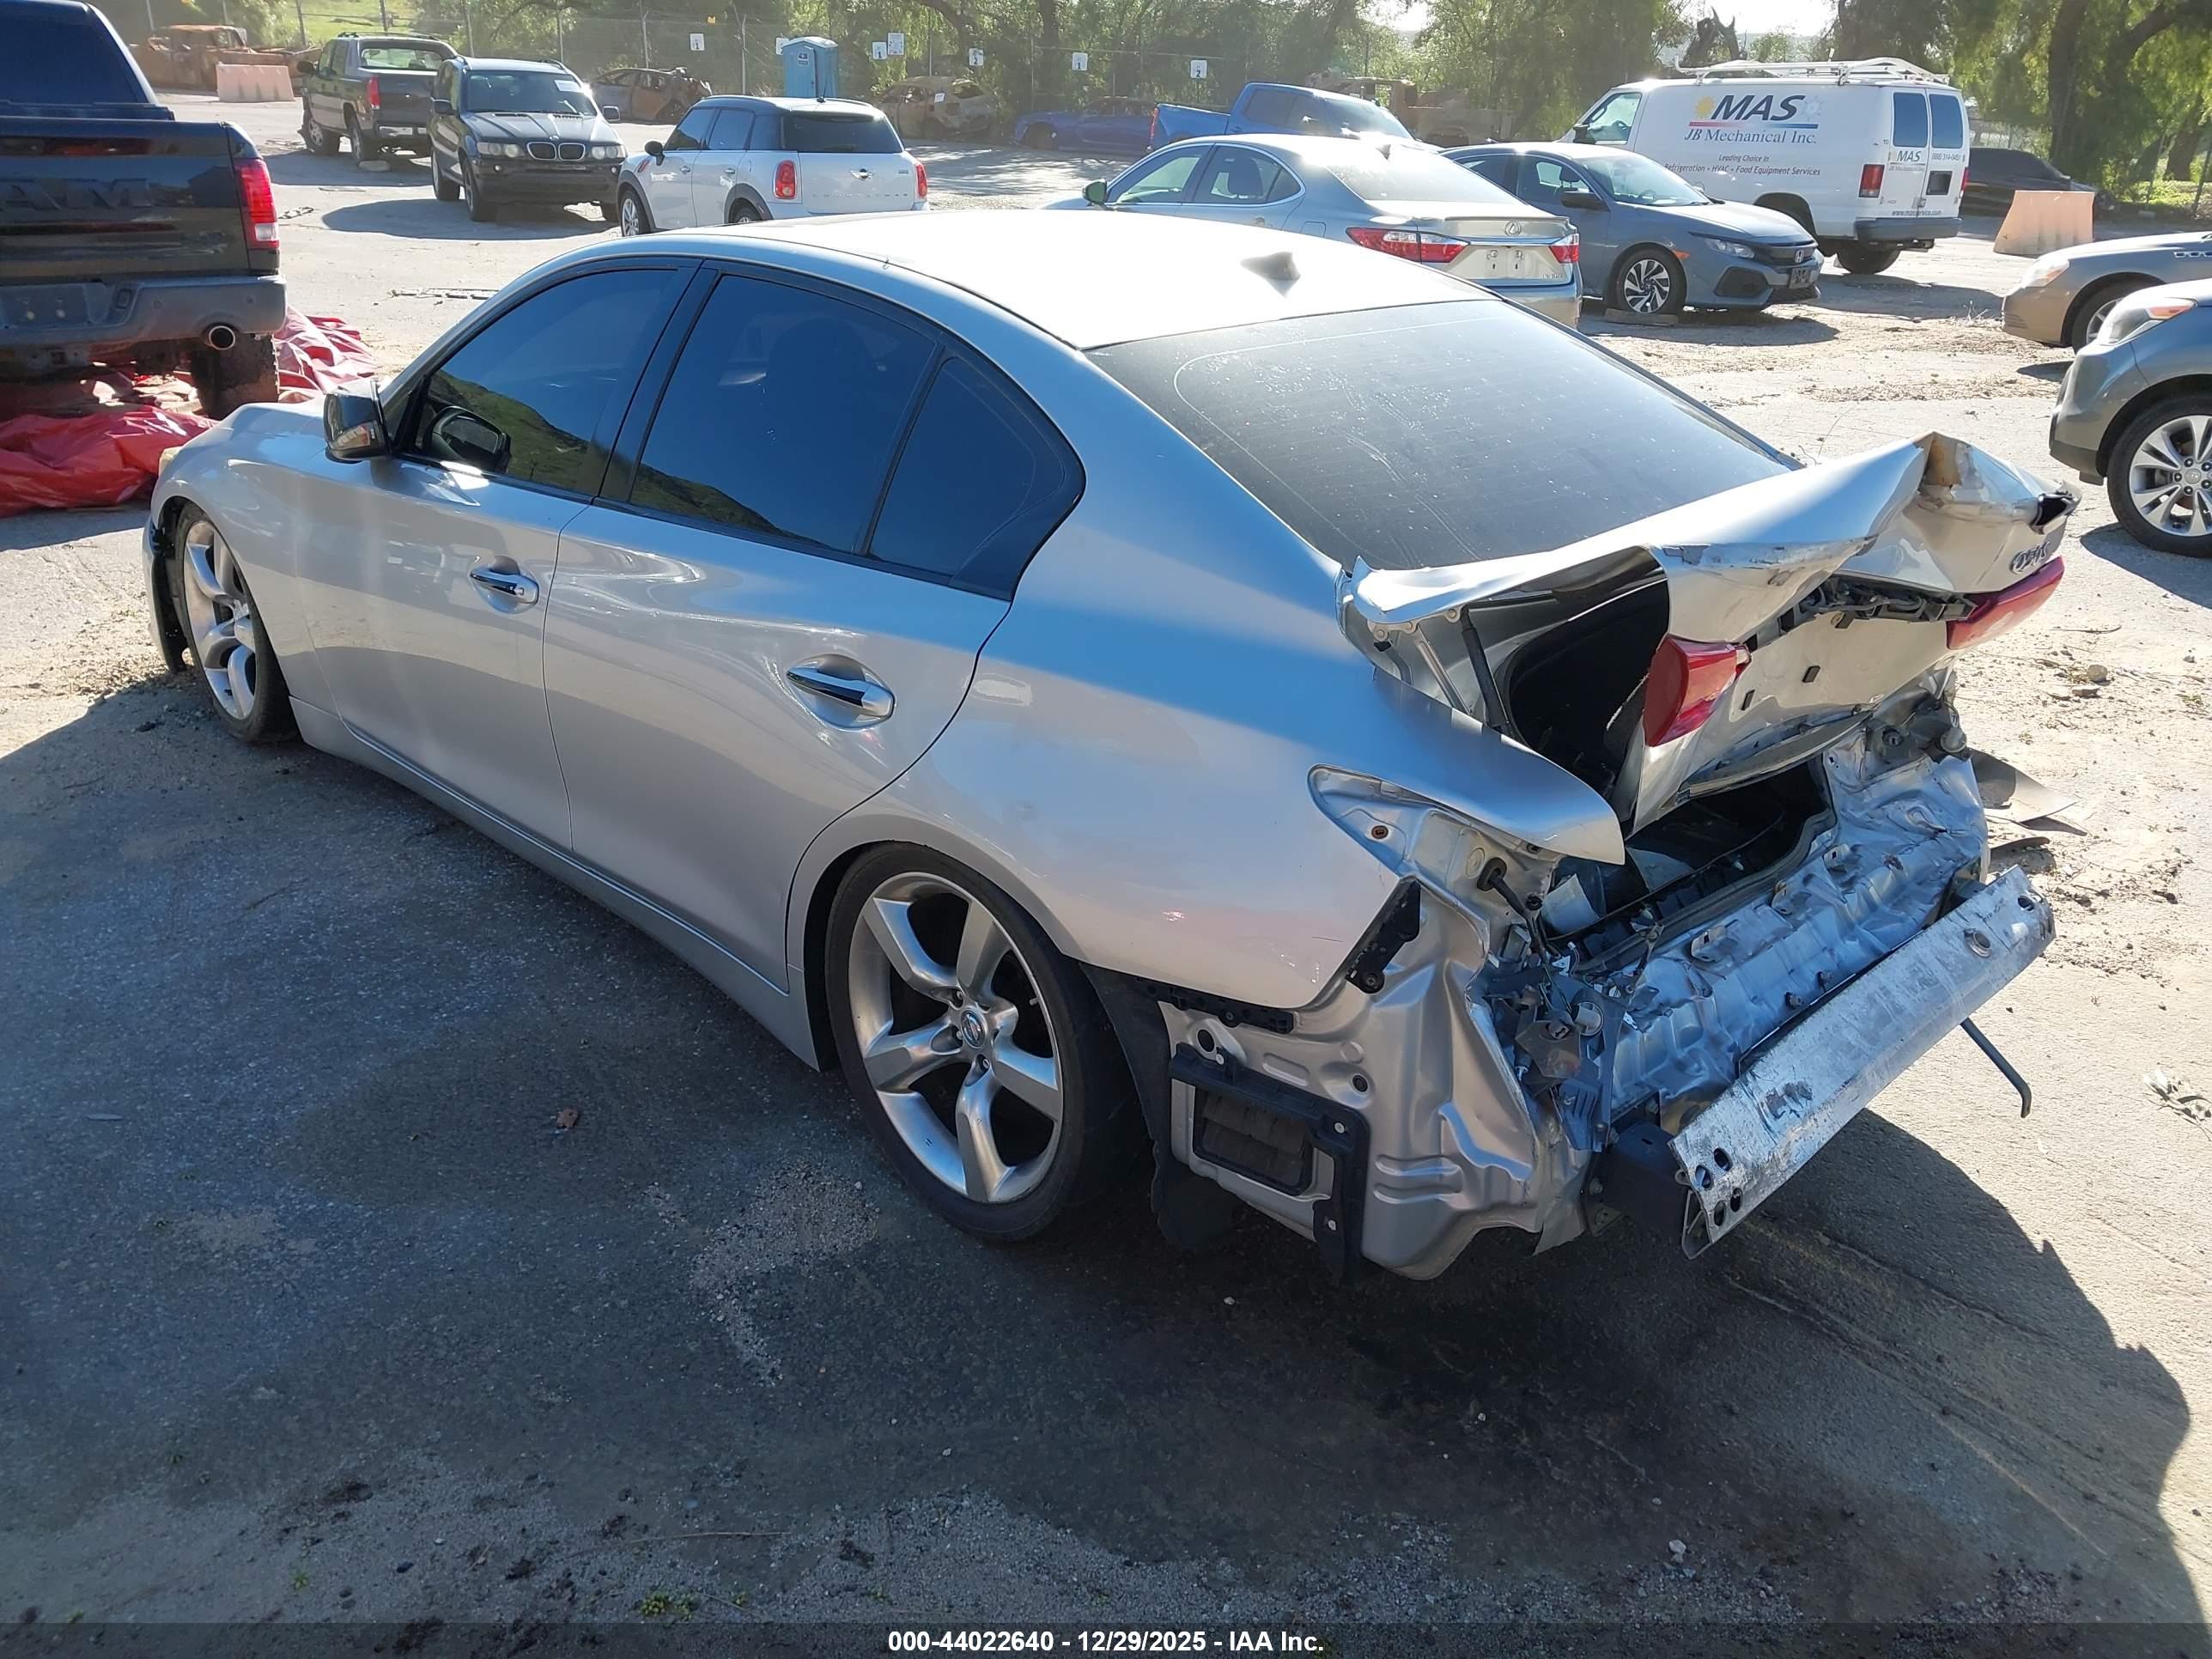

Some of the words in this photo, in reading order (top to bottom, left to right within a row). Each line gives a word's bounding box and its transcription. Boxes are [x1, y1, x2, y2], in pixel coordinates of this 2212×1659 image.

[1711, 94, 1806, 121] MAS
[1684, 128, 1703, 142] JB
[1705, 129, 1787, 143] Mechanical
[1790, 130, 1817, 144] Inc.
[1718, 154, 1741, 163] Leading
[1742, 155, 1762, 163] Choice
[1896, 150, 1922, 162] MAS
[1663, 162, 1705, 173] Refrigeration
[1711, 165, 1729, 173] HVAC
[1753, 166, 1790, 176] Equipment
[1791, 167, 1820, 176] Services
